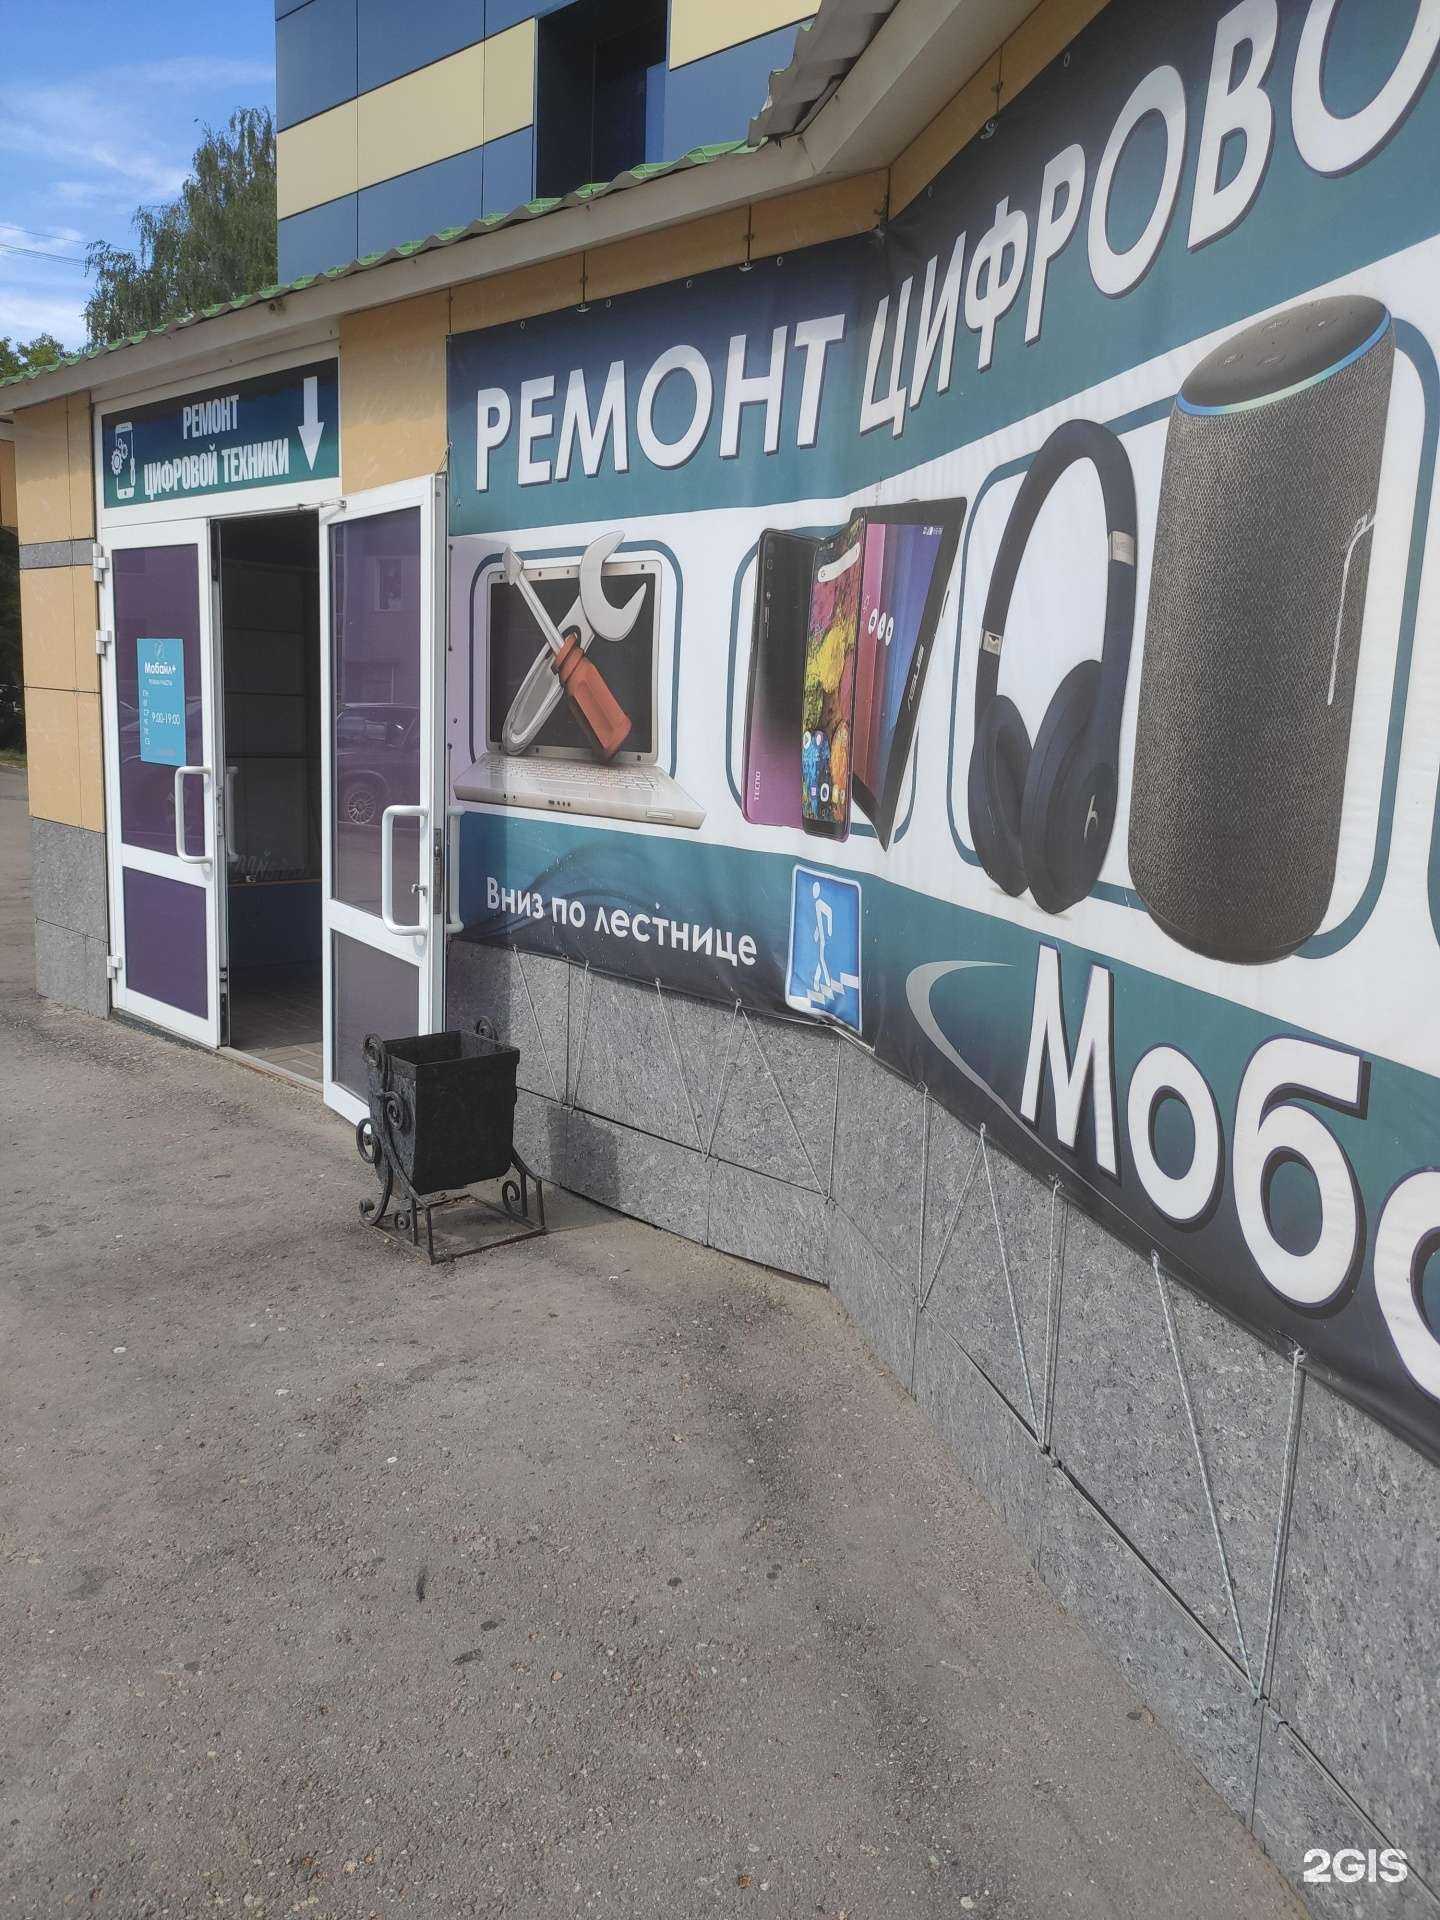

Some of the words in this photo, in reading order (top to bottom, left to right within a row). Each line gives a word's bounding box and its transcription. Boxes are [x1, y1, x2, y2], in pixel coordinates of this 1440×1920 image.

[182, 394, 240, 440] РЕМОНТ
[475, 313, 847, 493] РЕМОНТ
[143, 444, 218, 500] ЦИФРОВОЙ
[221, 438, 289, 481] ТЕХНИКИ
[486, 877, 544, 920] Вниз
[551, 897, 586, 928] по
[594, 906, 758, 967] лестнице
